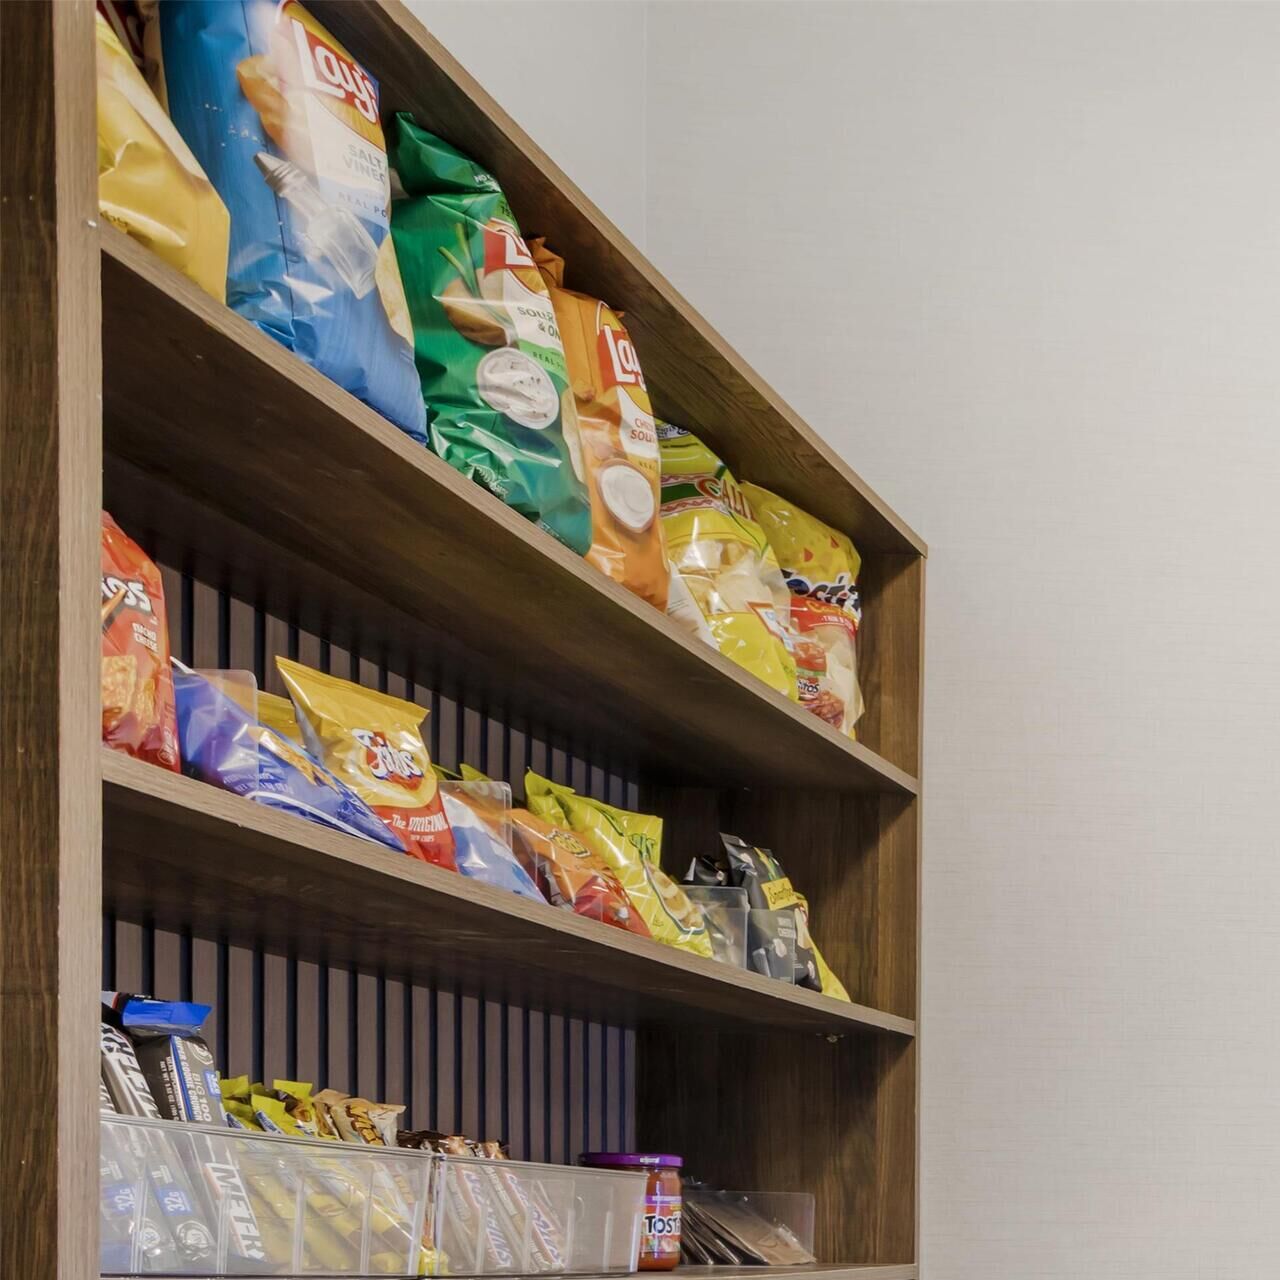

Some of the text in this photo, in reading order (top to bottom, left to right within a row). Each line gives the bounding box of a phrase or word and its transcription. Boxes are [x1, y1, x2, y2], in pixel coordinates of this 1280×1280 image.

[348, 145, 382, 166] SALT
[391, 813, 407, 830] The
[180, 1061, 197, 1091] COOKIE
[187, 1089, 204, 1121] CRUNCH
[191, 1072, 213, 1123] BIG 100
